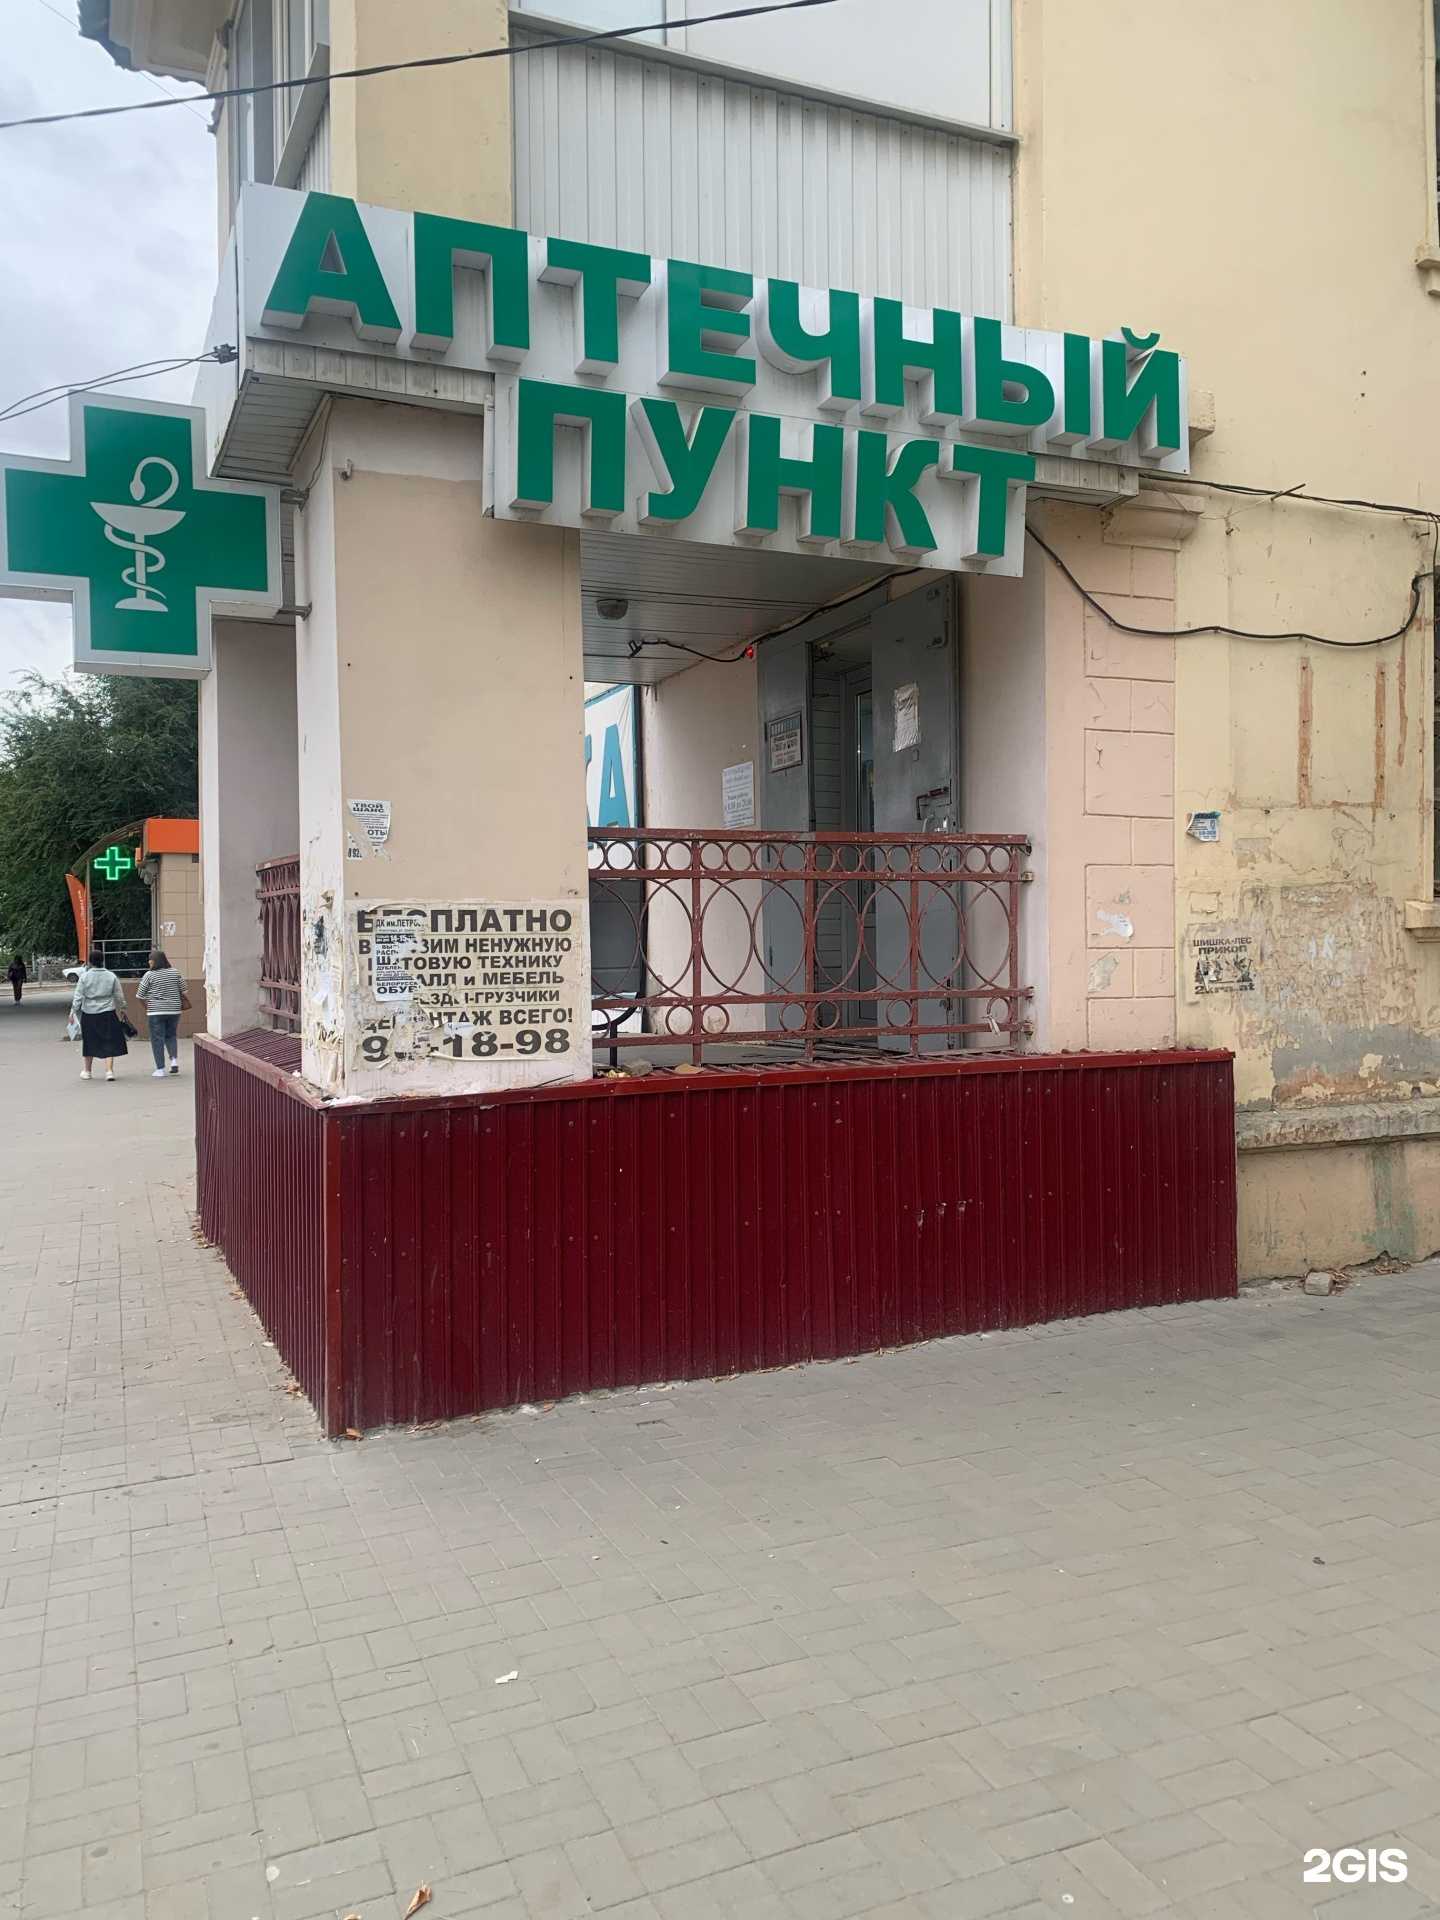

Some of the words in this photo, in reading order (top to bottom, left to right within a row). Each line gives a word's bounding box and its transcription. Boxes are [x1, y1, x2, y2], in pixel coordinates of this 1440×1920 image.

[260, 191, 1182, 459] АПТЕЧНЫЙ
[510, 378, 1036, 563] ПУНКТ
[357, 909, 572, 933] БПЛАТНО
[358, 938, 459, 955] ВЗИМ
[465, 937, 572, 953] НЕНУЖНУЮ
[367, 956, 472, 971] ТОВУЮ
[478, 954, 563, 969] ТЕХНИКУ
[482, 971, 565, 986] МЕБЕЛЬ
[500, 1008, 573, 1026] ВСЕГО!
